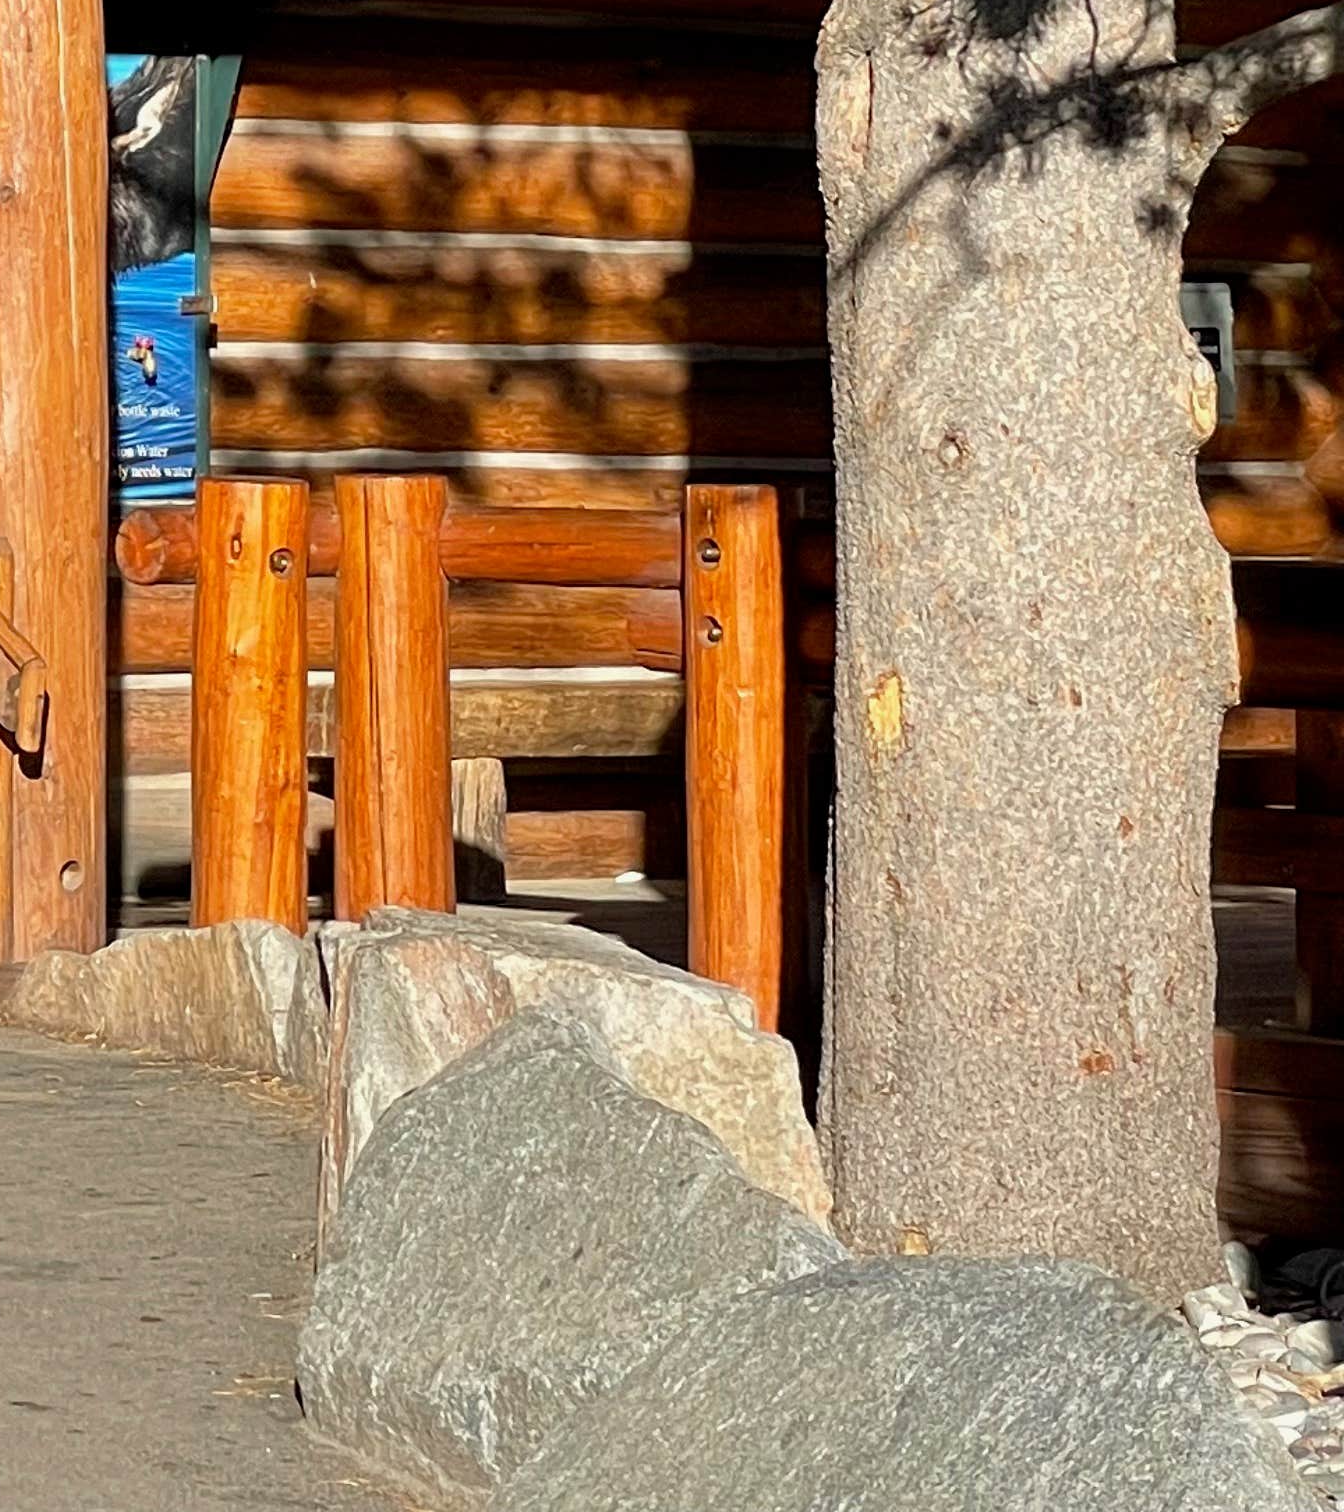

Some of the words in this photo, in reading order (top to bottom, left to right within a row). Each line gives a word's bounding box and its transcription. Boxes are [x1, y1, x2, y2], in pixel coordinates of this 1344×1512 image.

[136, 445, 169, 457] Water
[131, 464, 162, 478] needs
[163, 466, 193, 478] water
